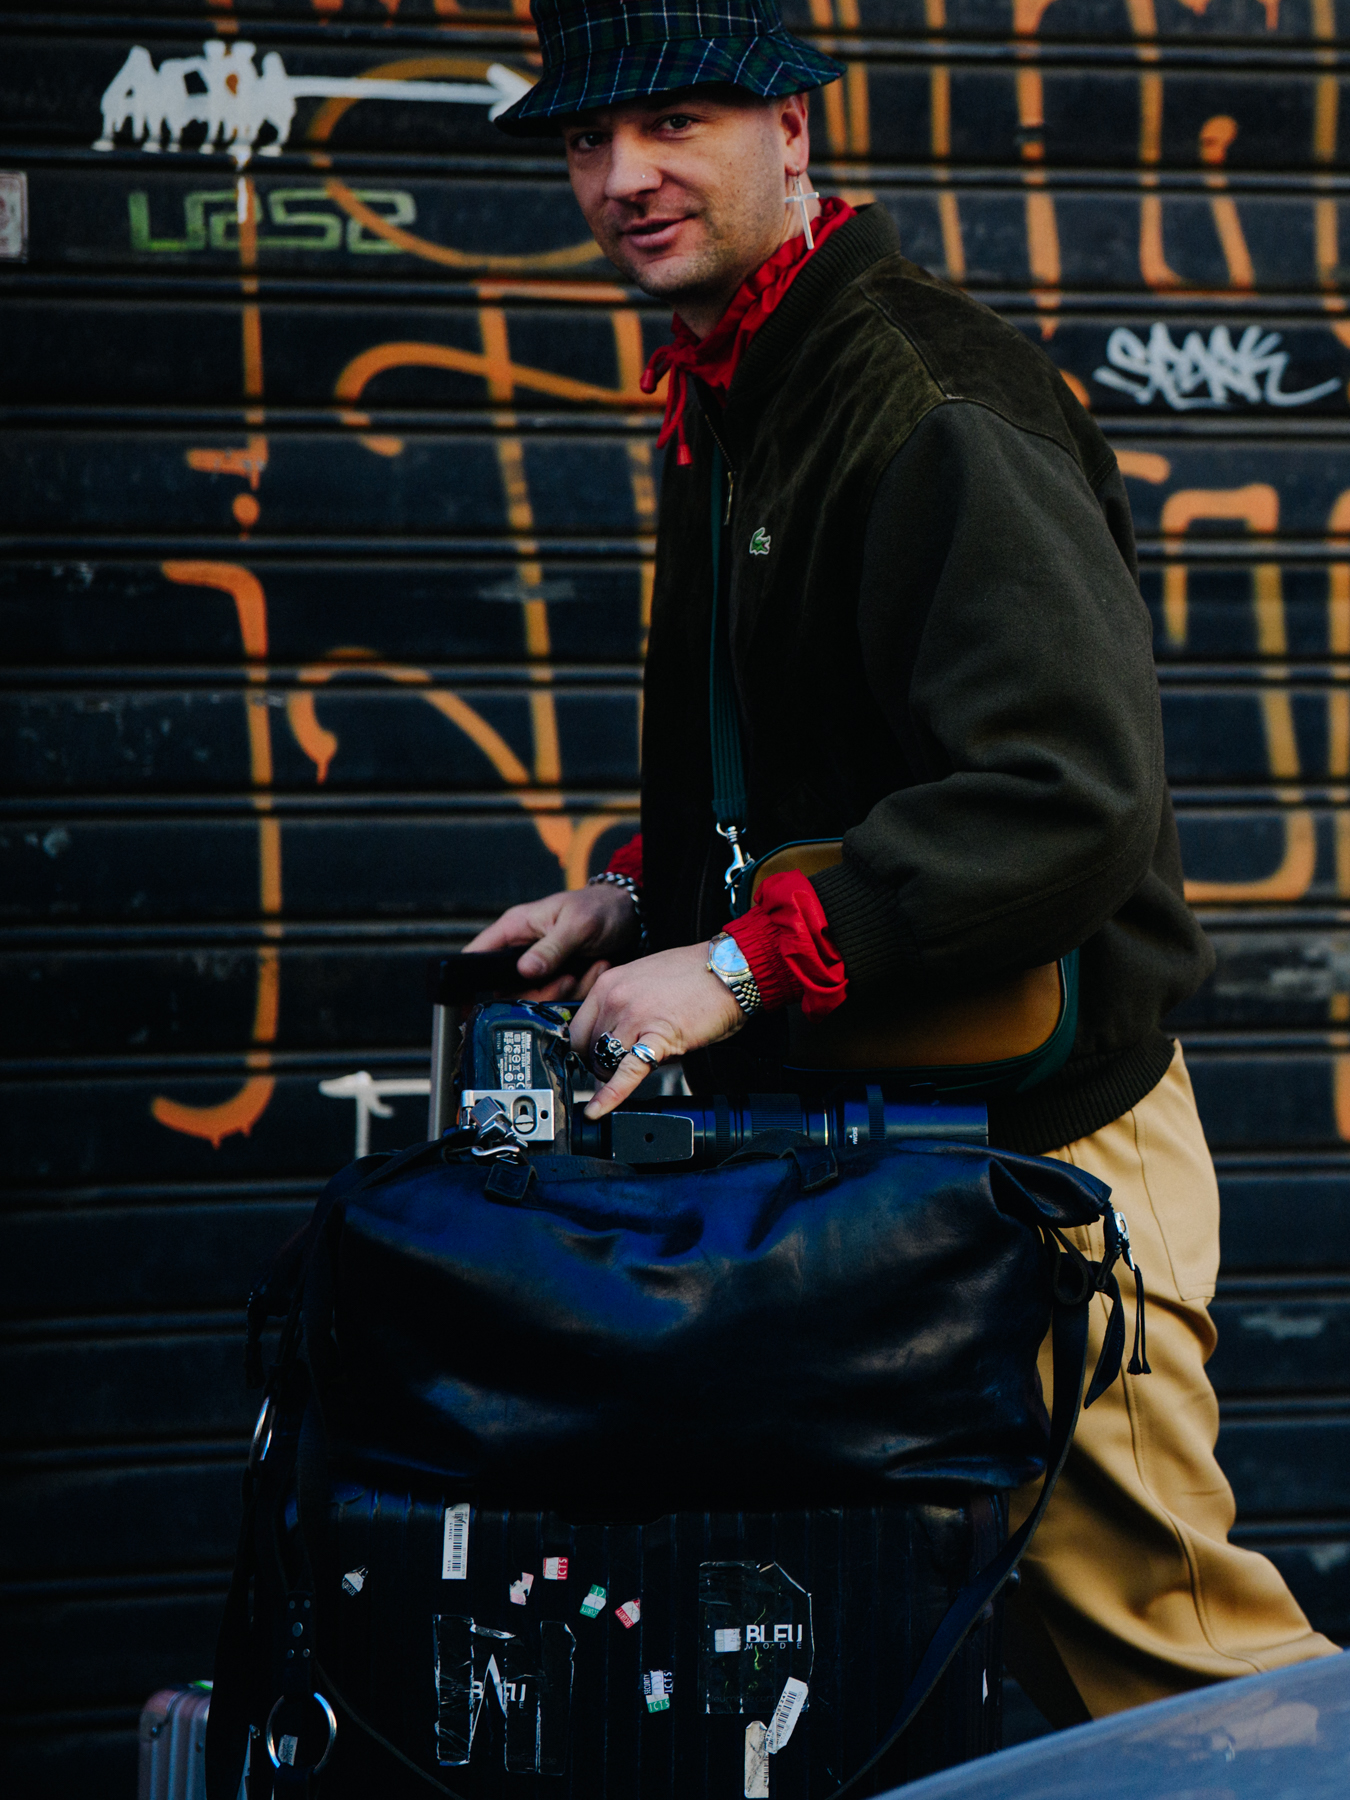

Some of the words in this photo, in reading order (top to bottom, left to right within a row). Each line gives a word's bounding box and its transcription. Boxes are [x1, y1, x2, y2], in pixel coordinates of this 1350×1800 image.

[557, 1558, 568, 1579] ICTS
[746, 1624, 803, 1643] BLEU
[745, 1642, 802, 1650] MODE
[663, 1671, 673, 1693] ICTS
[650, 1699, 670, 1711] ICTS
